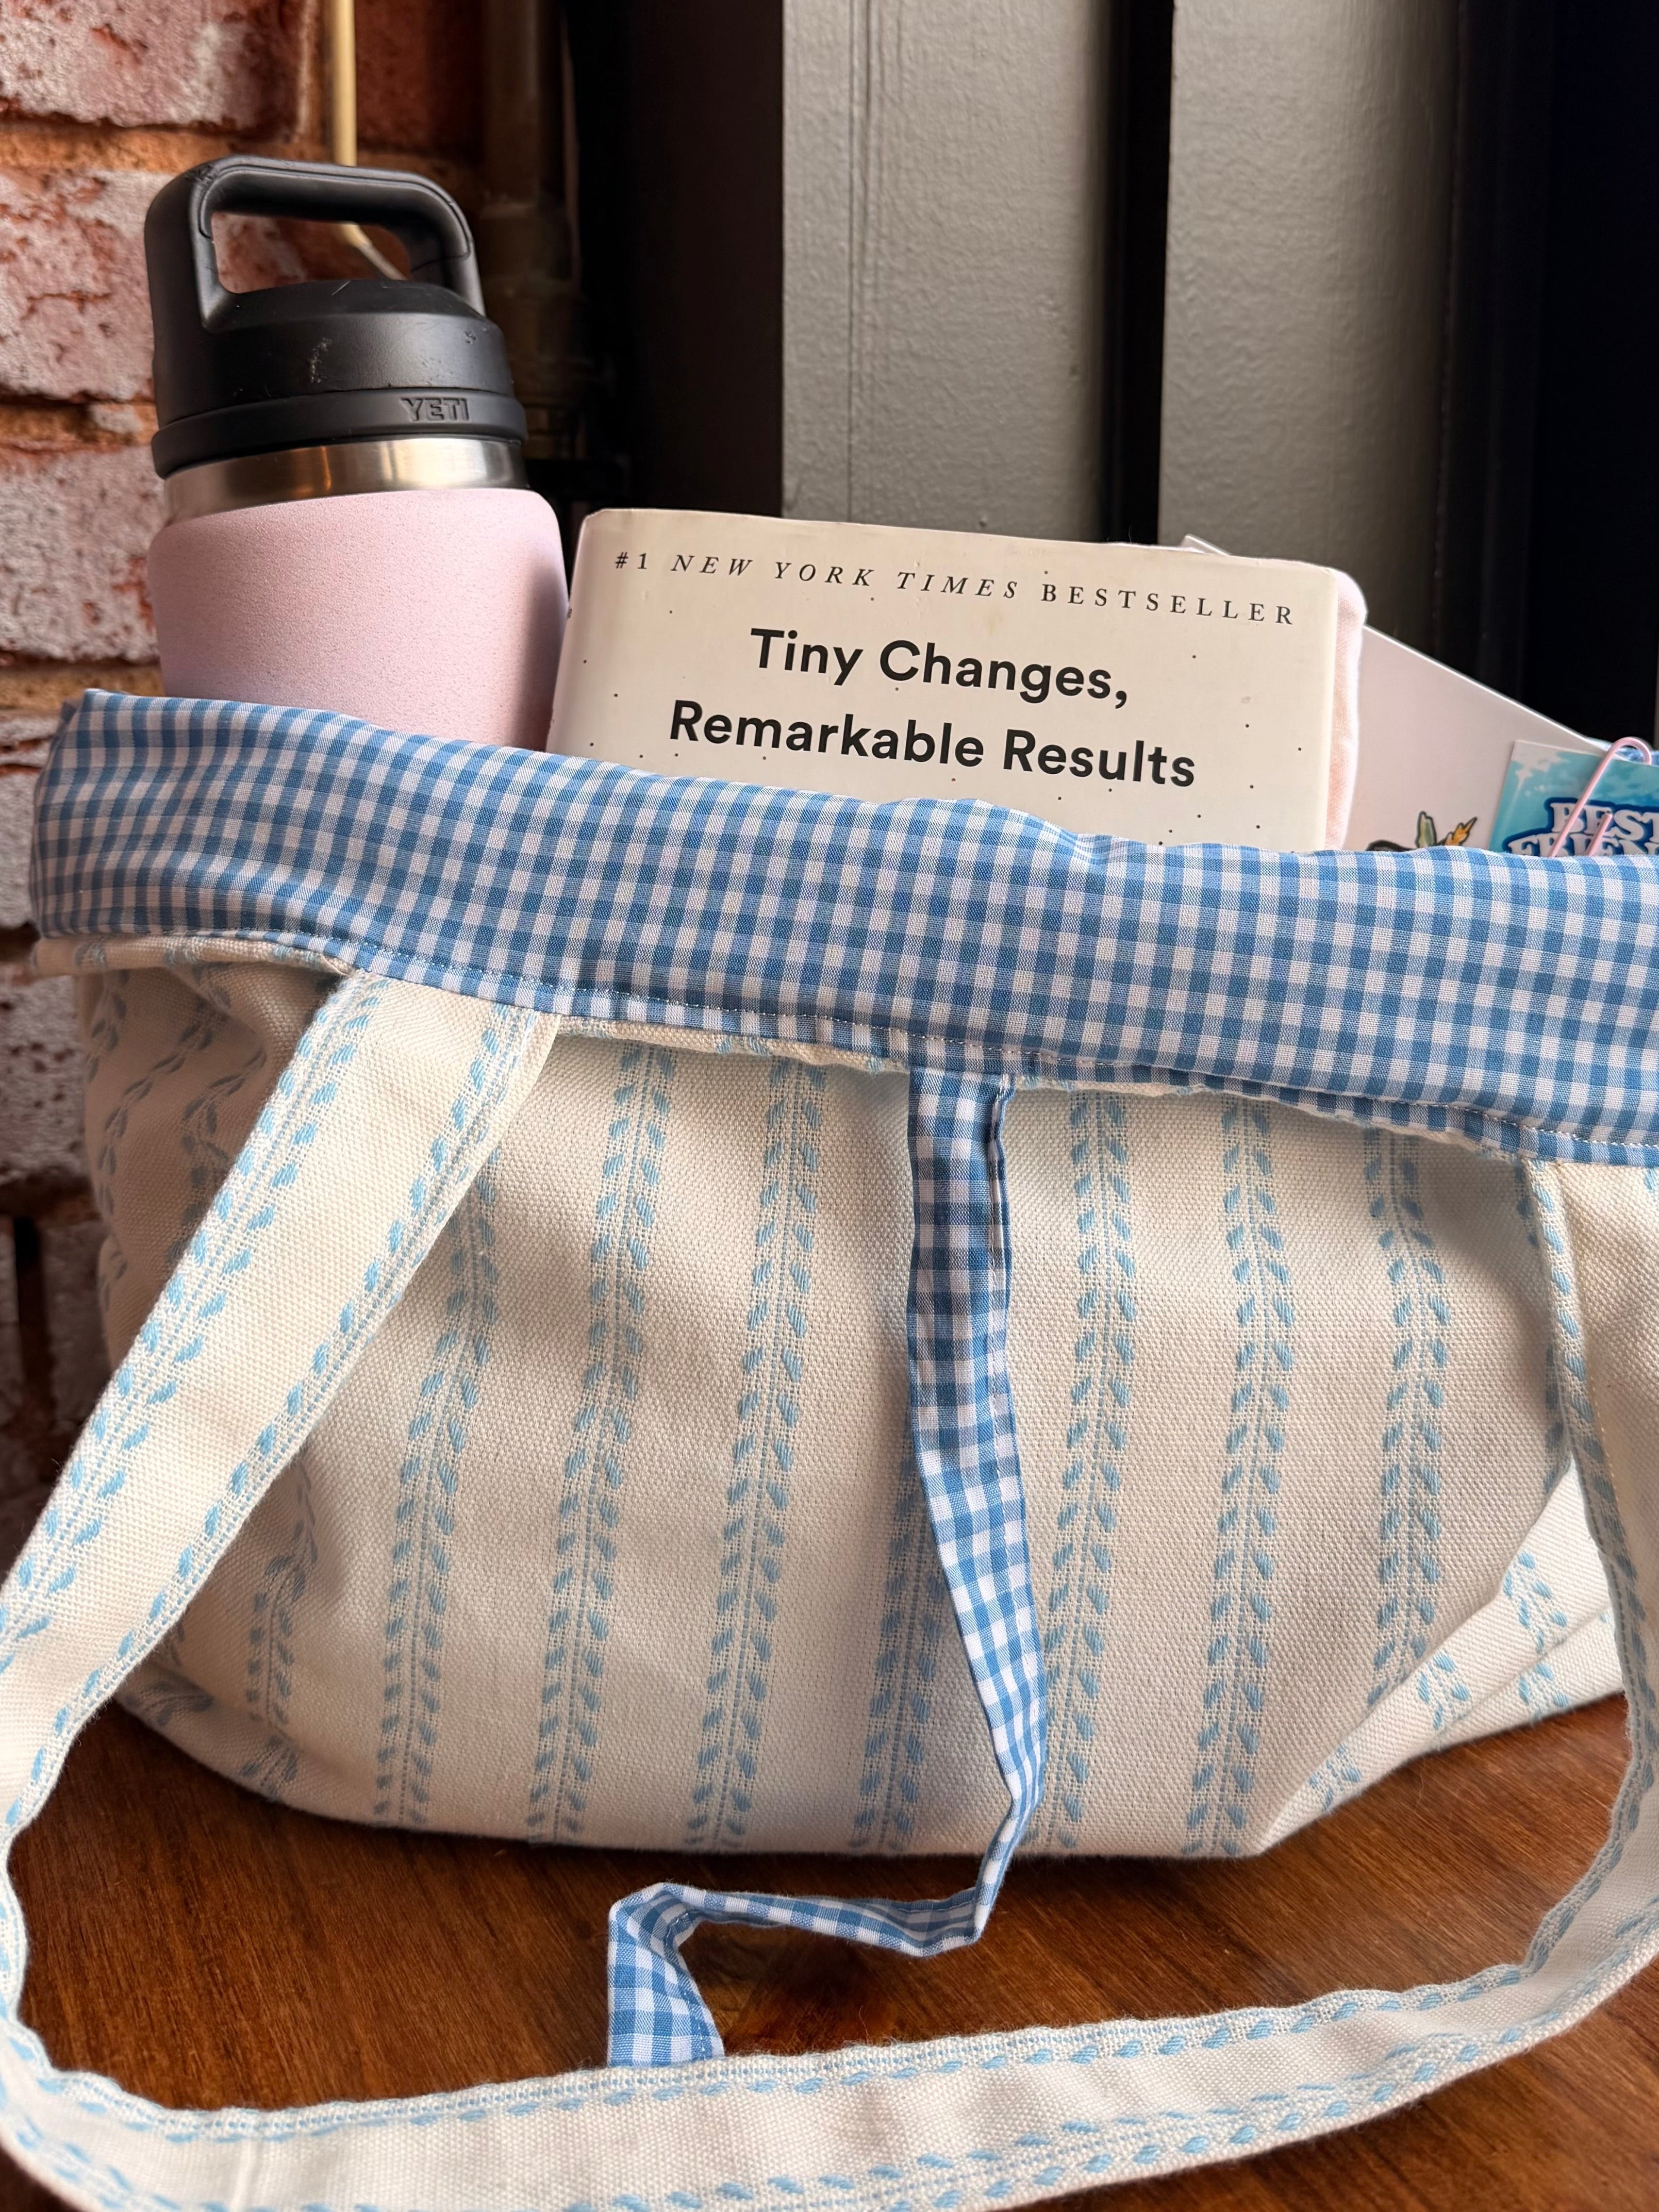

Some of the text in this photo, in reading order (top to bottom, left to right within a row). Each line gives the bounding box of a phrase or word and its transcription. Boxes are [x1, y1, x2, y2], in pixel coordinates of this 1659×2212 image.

[400, 396, 470, 422] YETI
[616, 552, 1293, 625] #1 NEW YORK TIMES BESTSELLER
[750, 627, 1127, 709] Tiny Changes,
[670, 700, 1195, 787] Remarkable Results
